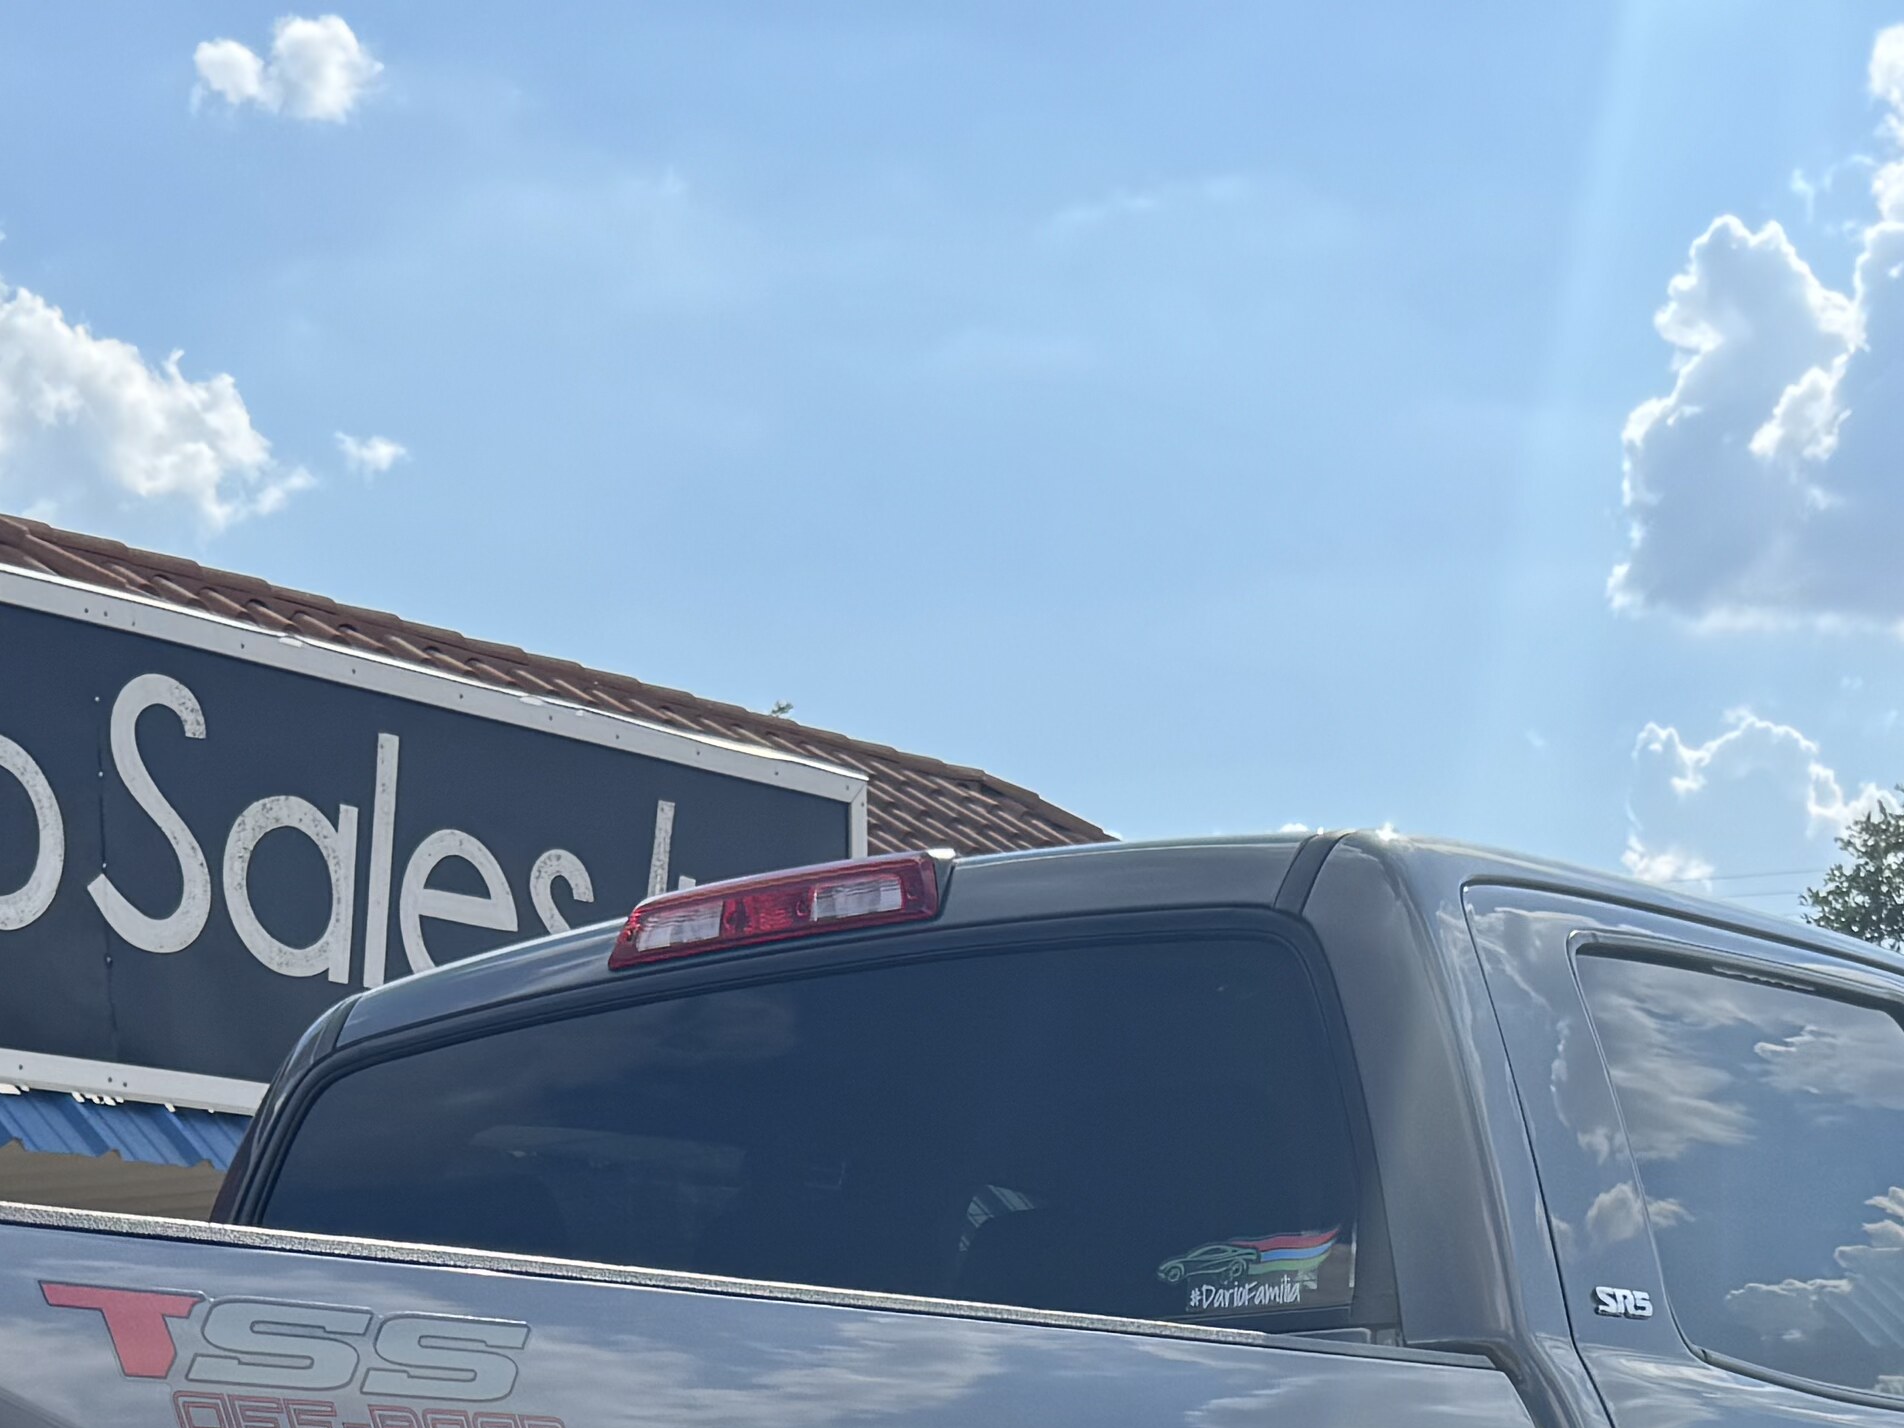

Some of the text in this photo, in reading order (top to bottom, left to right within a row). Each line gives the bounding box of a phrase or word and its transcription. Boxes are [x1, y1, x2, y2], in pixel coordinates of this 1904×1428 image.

[1189, 1274, 1301, 1309] #DarioFamilia
[1595, 1286, 1653, 1316] SR5
[38, 1280, 531, 1402] TSS
